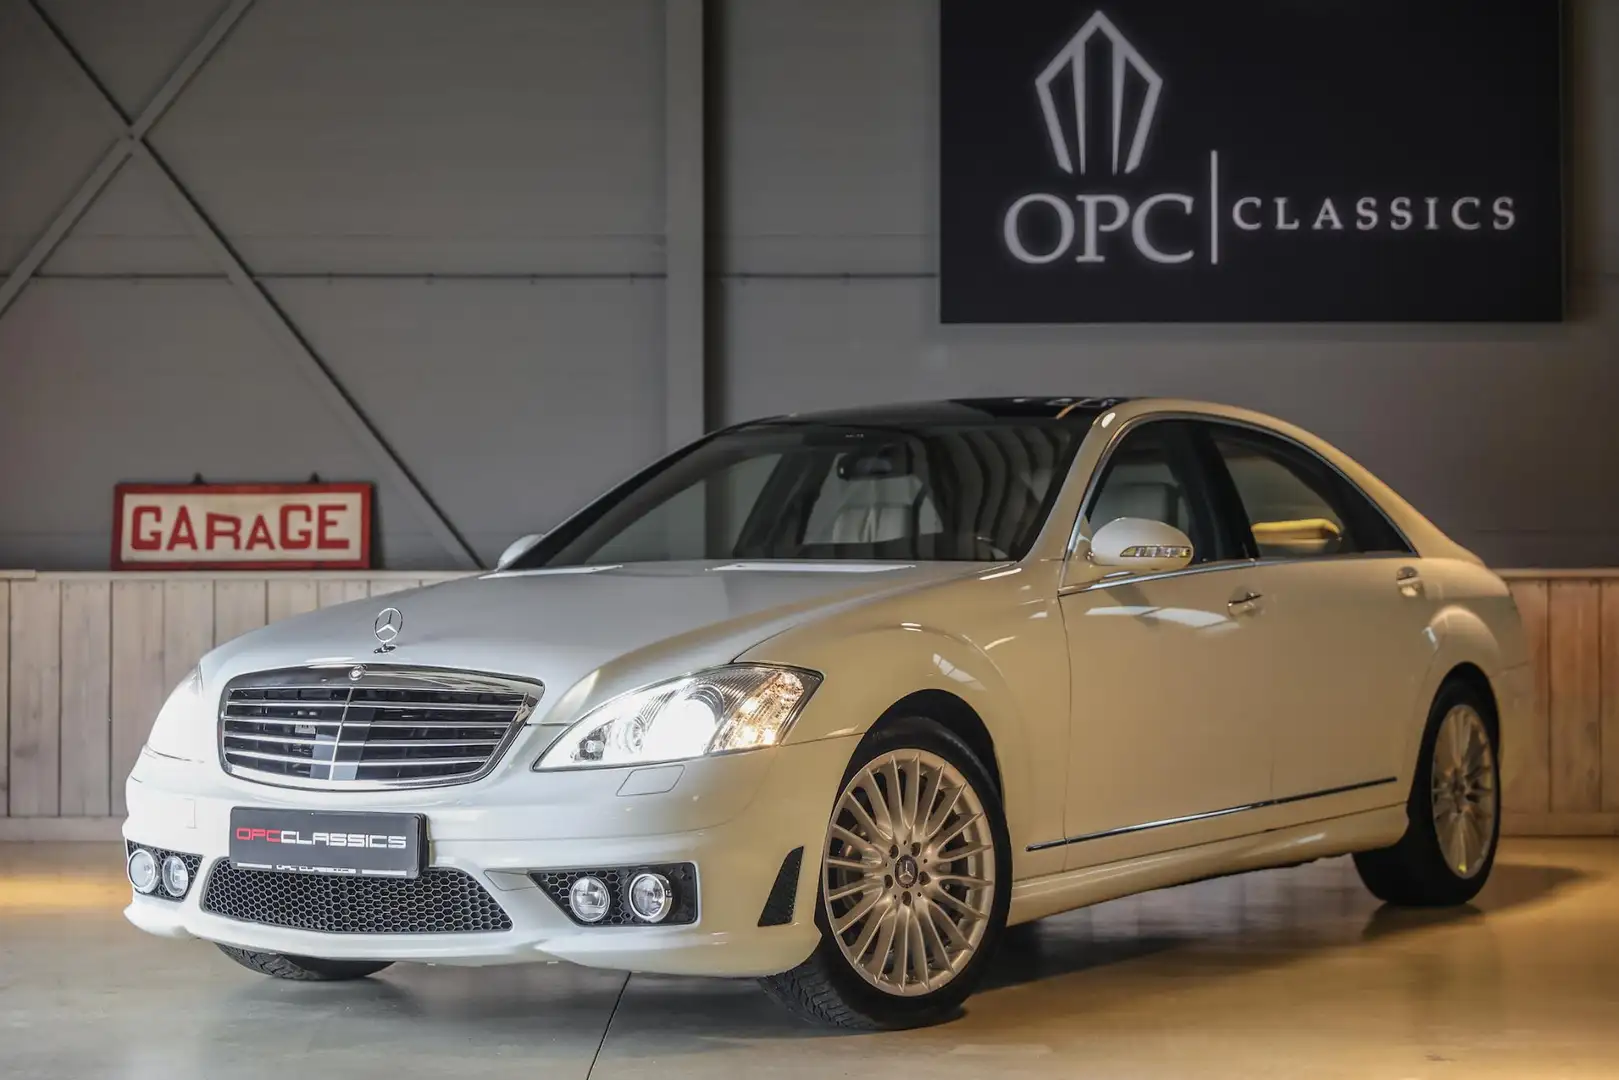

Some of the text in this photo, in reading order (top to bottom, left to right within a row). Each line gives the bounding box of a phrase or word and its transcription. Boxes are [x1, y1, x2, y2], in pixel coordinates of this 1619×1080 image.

[1003, 193, 1516, 264] OPC CLASSICS
[130, 504, 350, 550] GARAGE
